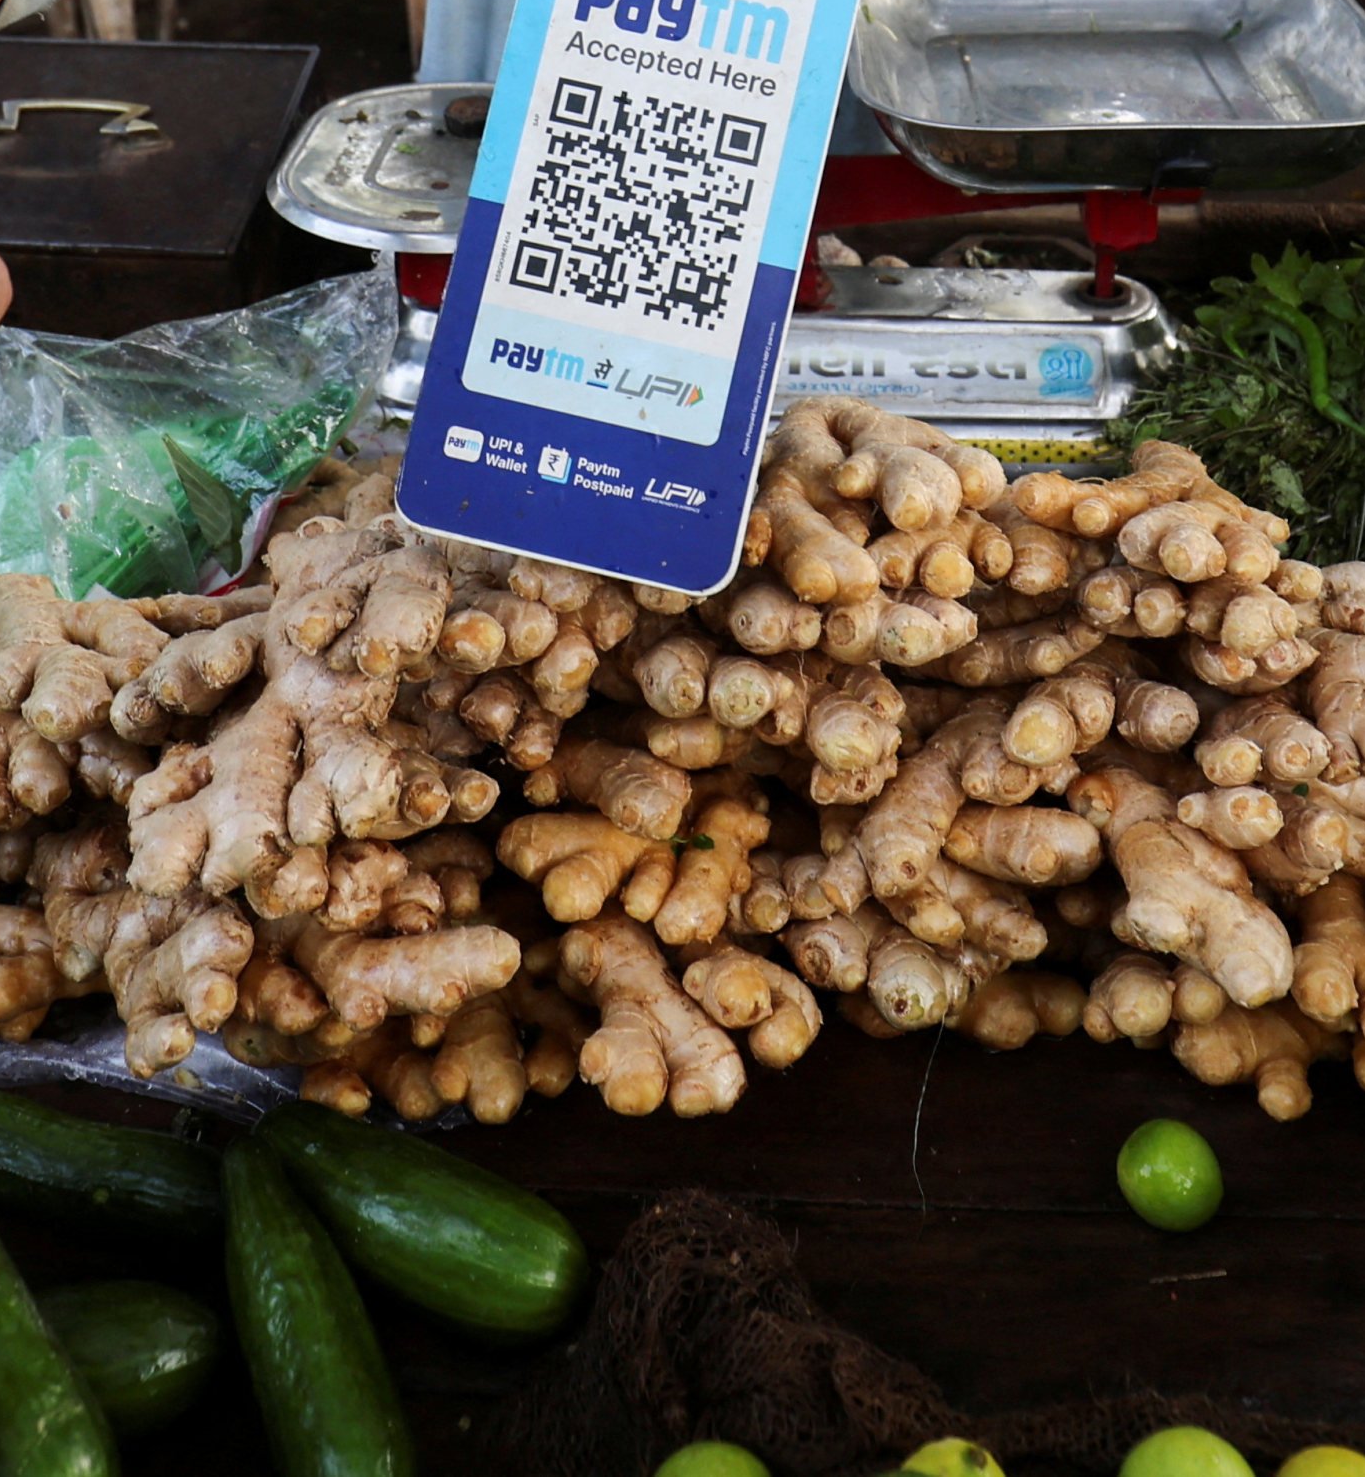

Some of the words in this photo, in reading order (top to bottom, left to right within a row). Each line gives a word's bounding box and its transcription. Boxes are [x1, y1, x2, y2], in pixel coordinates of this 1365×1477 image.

[565, 30, 703, 81] Accepted
[709, 60, 777, 97] Here
[594, 359, 613, 380] से
[614, 368, 692, 407] UPI
[488, 436, 512, 454] UPI
[514, 442, 524, 456] &
[485, 453, 528, 474] Wallet
[577, 457, 621, 479] Paytm
[573, 474, 634, 499] Postpaid
[644, 478, 698, 505] UPI
